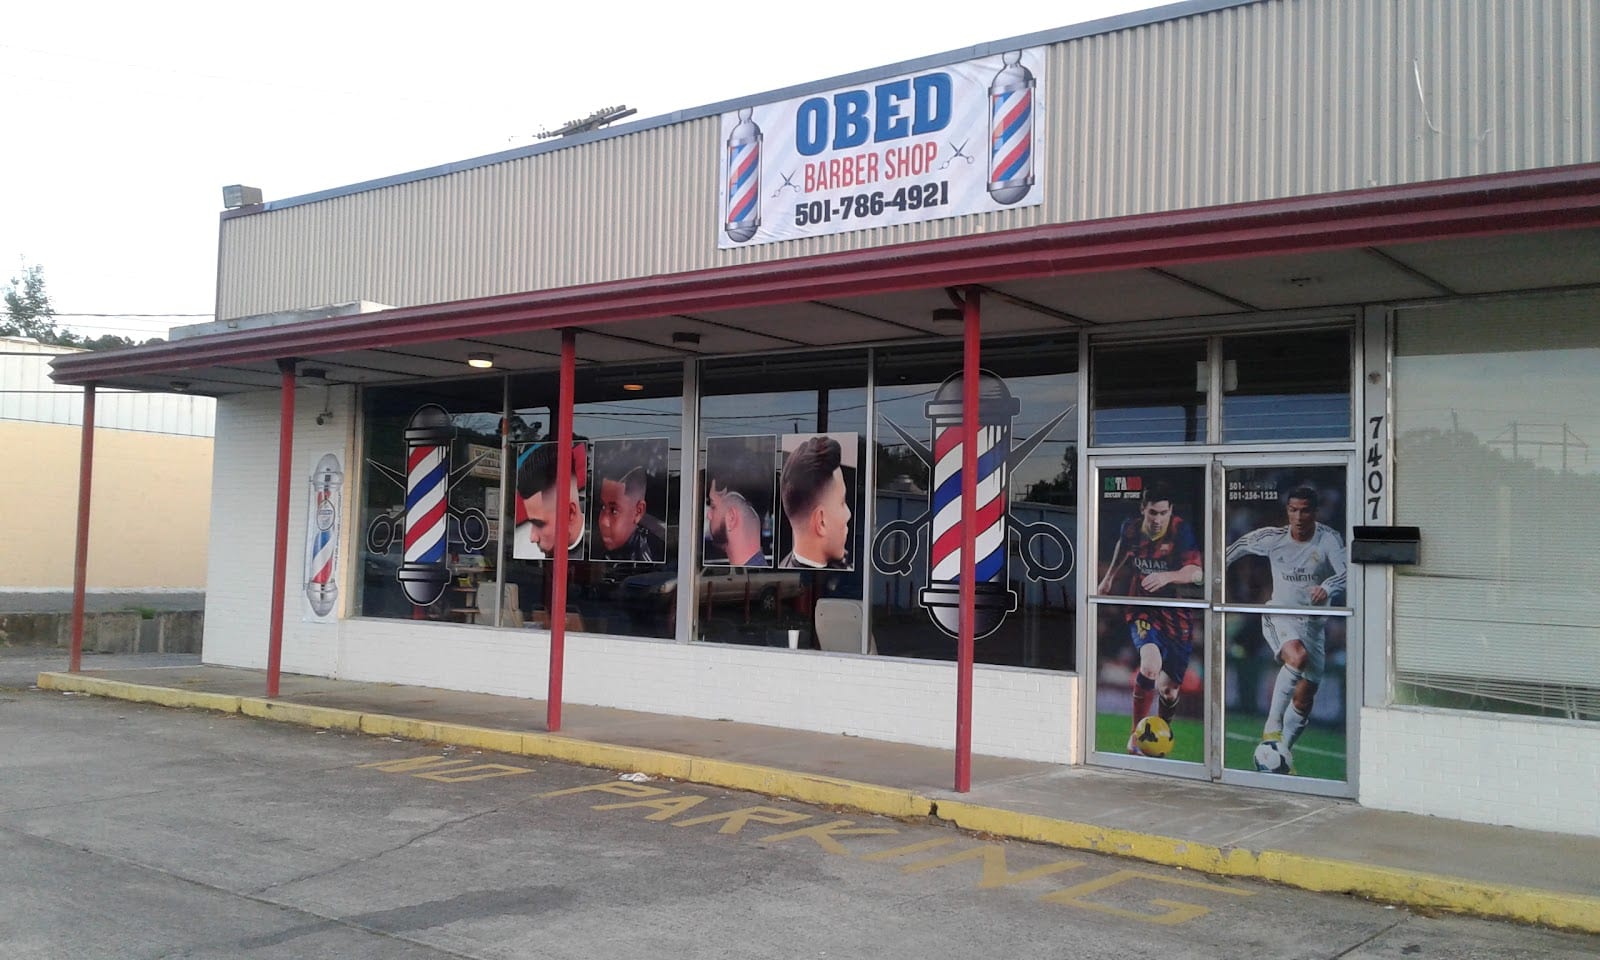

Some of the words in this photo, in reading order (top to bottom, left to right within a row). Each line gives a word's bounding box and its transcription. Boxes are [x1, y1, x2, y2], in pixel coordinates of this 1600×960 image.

[796, 72, 952, 156] OBED
[794, 180, 949, 226] 501-786-4921
[803, 152, 880, 193] BARBER
[884, 141, 938, 180] SHOP
[1367, 416, 1384, 520] 7407
[354, 755, 537, 783] NO
[530, 780, 1259, 926] PARKING
